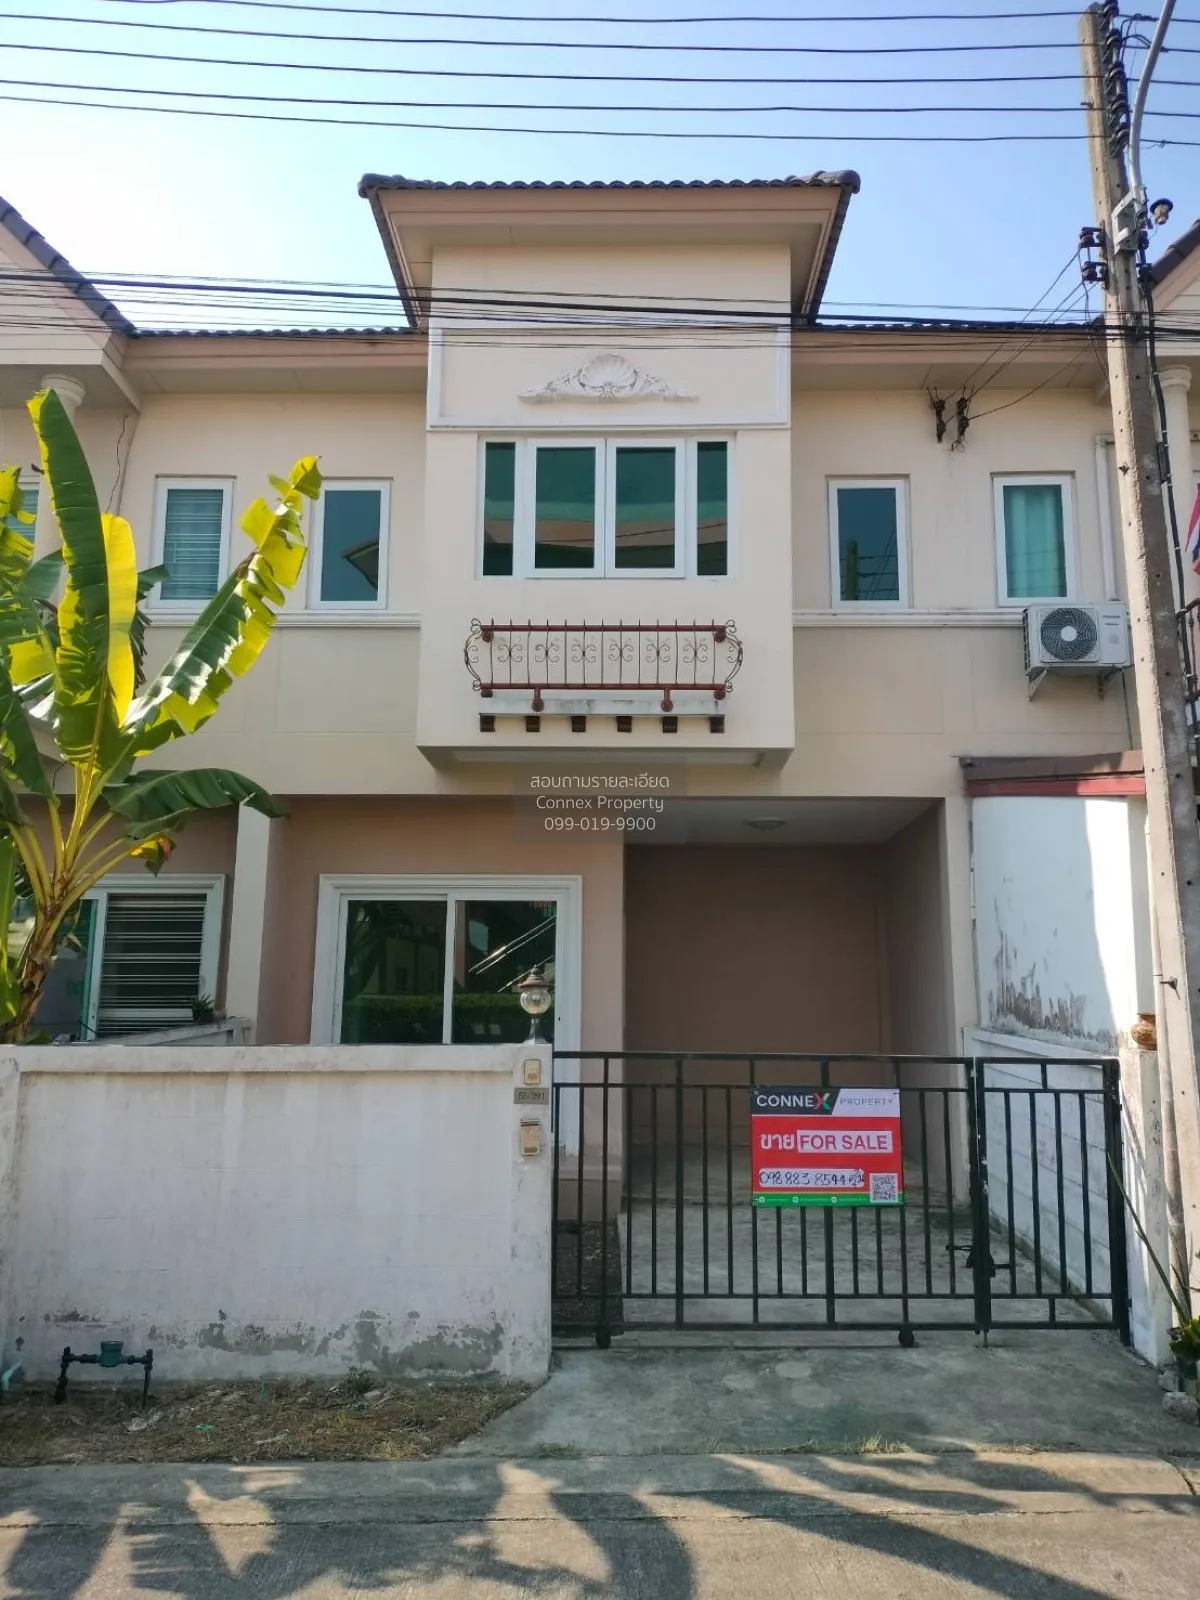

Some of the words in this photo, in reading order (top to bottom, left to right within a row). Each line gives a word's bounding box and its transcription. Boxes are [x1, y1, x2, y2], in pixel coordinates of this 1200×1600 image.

[756, 1092, 831, 1110] CONNEX
[840, 1097, 894, 1106] PROPERTY
[760, 1133, 795, 1150] ขาย
[800, 1135, 837, 1150] FOR
[842, 1134, 888, 1150] SALE
